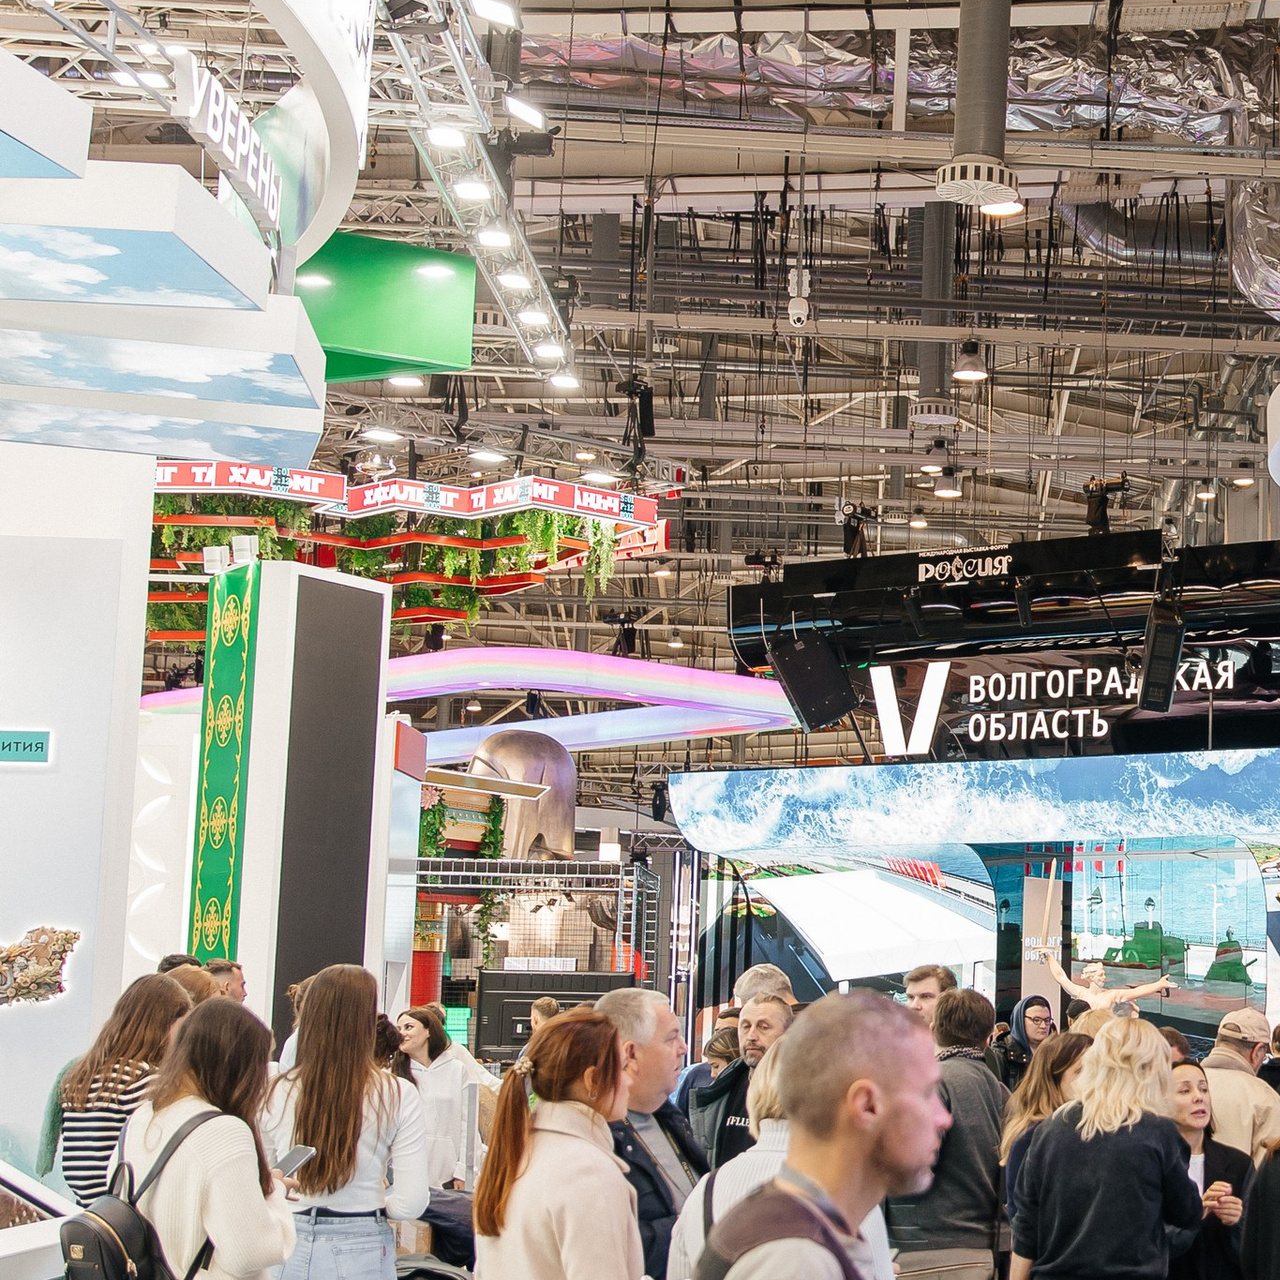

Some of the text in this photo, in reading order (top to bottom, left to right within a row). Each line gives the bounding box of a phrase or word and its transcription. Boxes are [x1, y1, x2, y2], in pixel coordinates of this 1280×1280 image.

[189, 52, 282, 231] УВЕРЕНЫ
[228, 466, 325, 494] ХАЛМГ
[968, 660, 1236, 704] ВОЛГОГРАДКАЯ
[968, 708, 1109, 742] ОБЛАСТЬ
